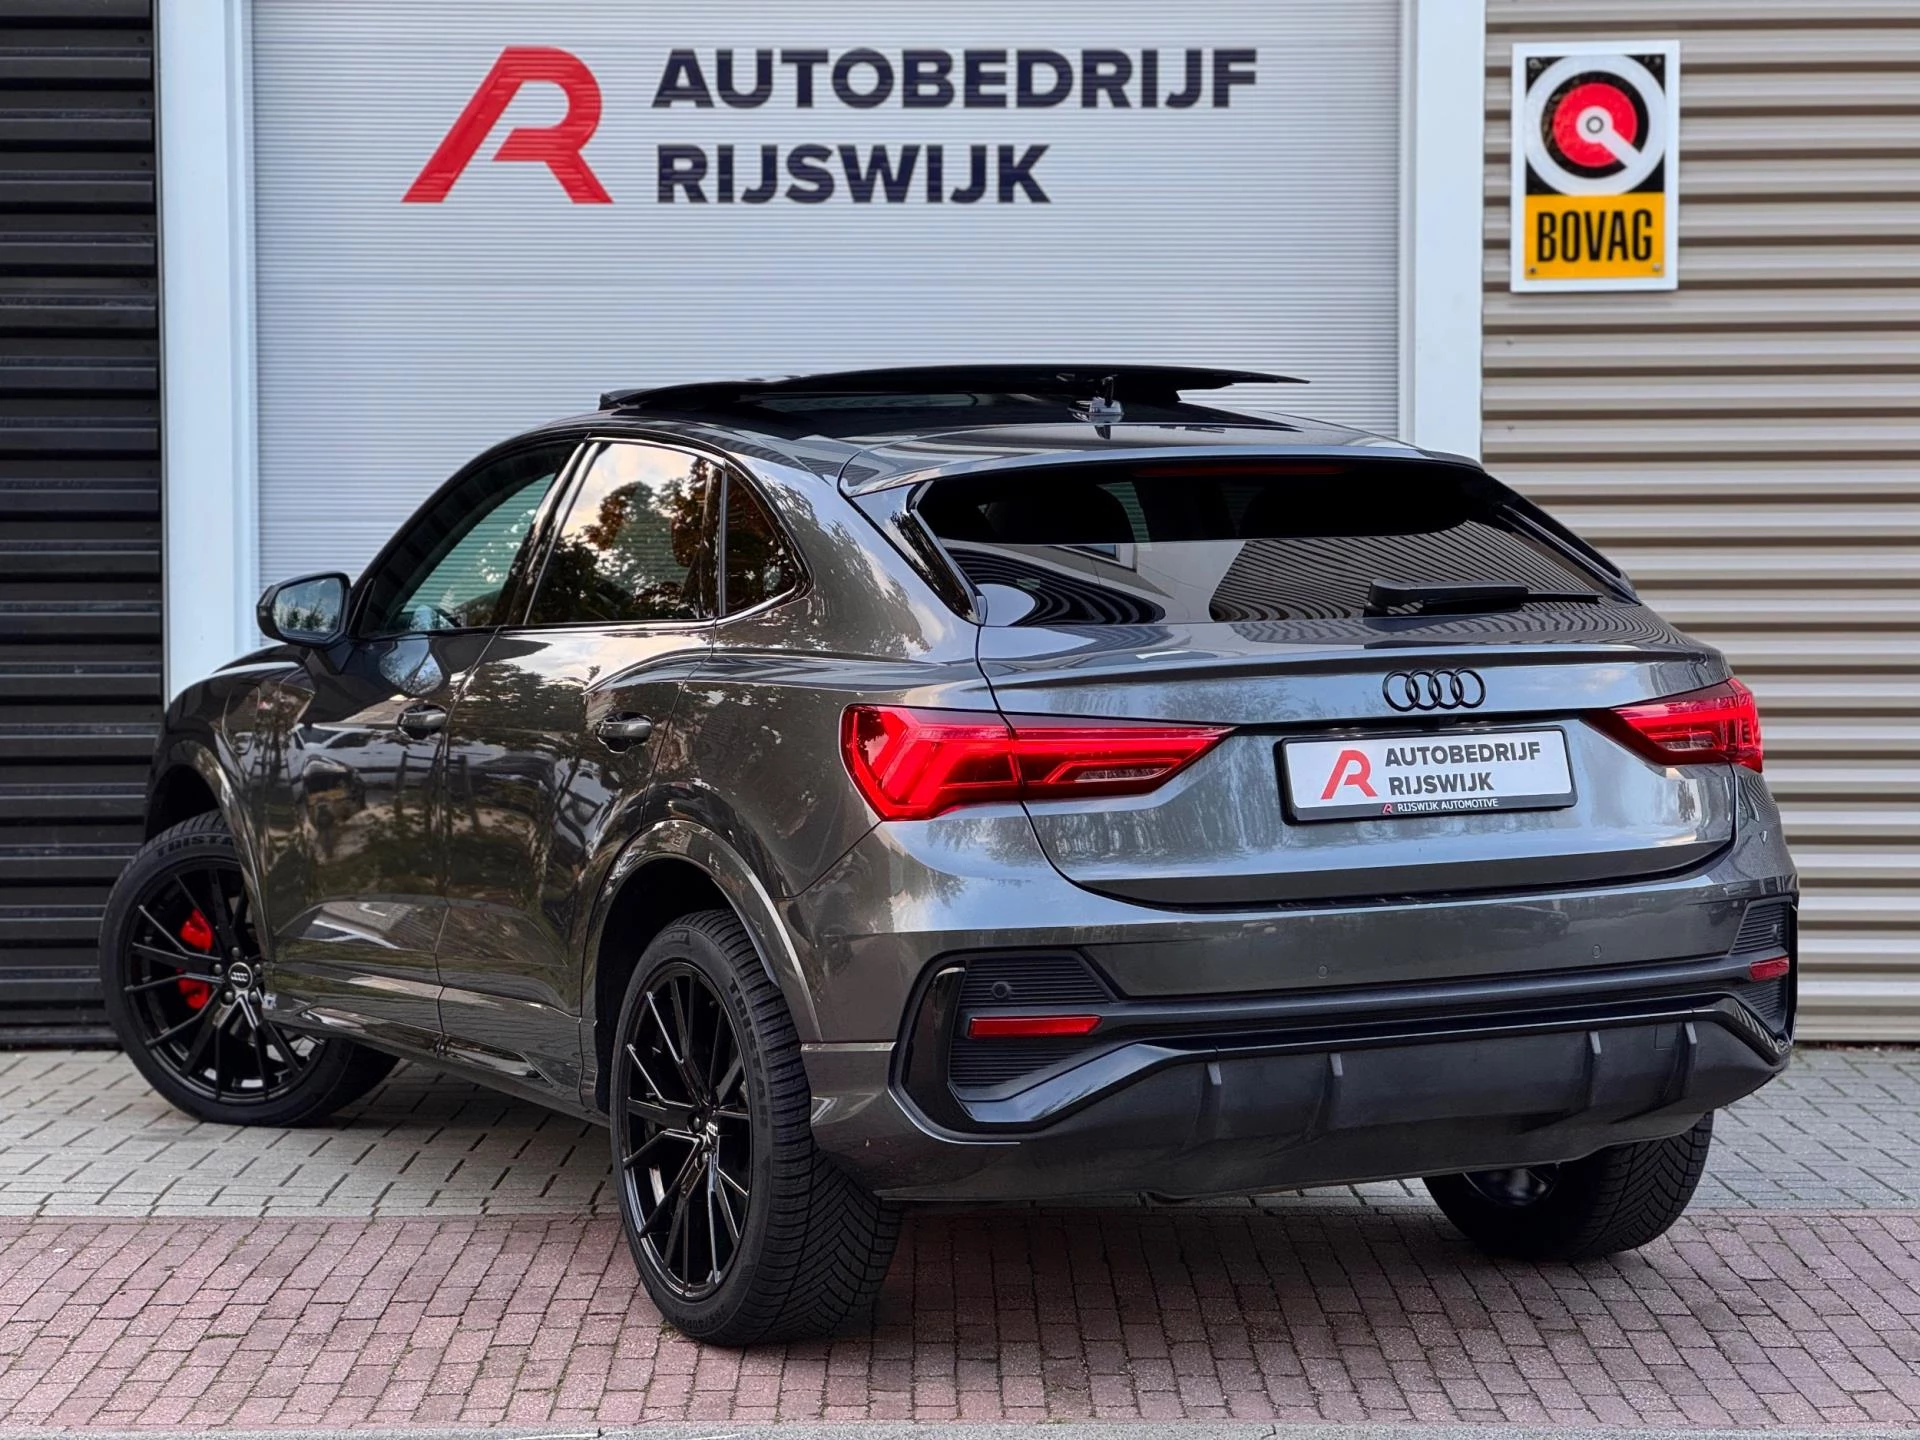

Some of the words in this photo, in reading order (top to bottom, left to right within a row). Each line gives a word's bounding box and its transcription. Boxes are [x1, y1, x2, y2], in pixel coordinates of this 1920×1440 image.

[652, 48, 1257, 109] AUTOBEDRIJF
[657, 144, 1051, 204] RIJSWIJK
[1537, 209, 1652, 263] BOVAG
[1385, 741, 1541, 767] AUTOBEDRIJF
[1389, 772, 1494, 796] RIJSWIJK
[1397, 801, 1440, 812] RIJSWIJK
[1441, 798, 1499, 810] AUTOMOTIVE
[157, 834, 234, 858] TRISTA
